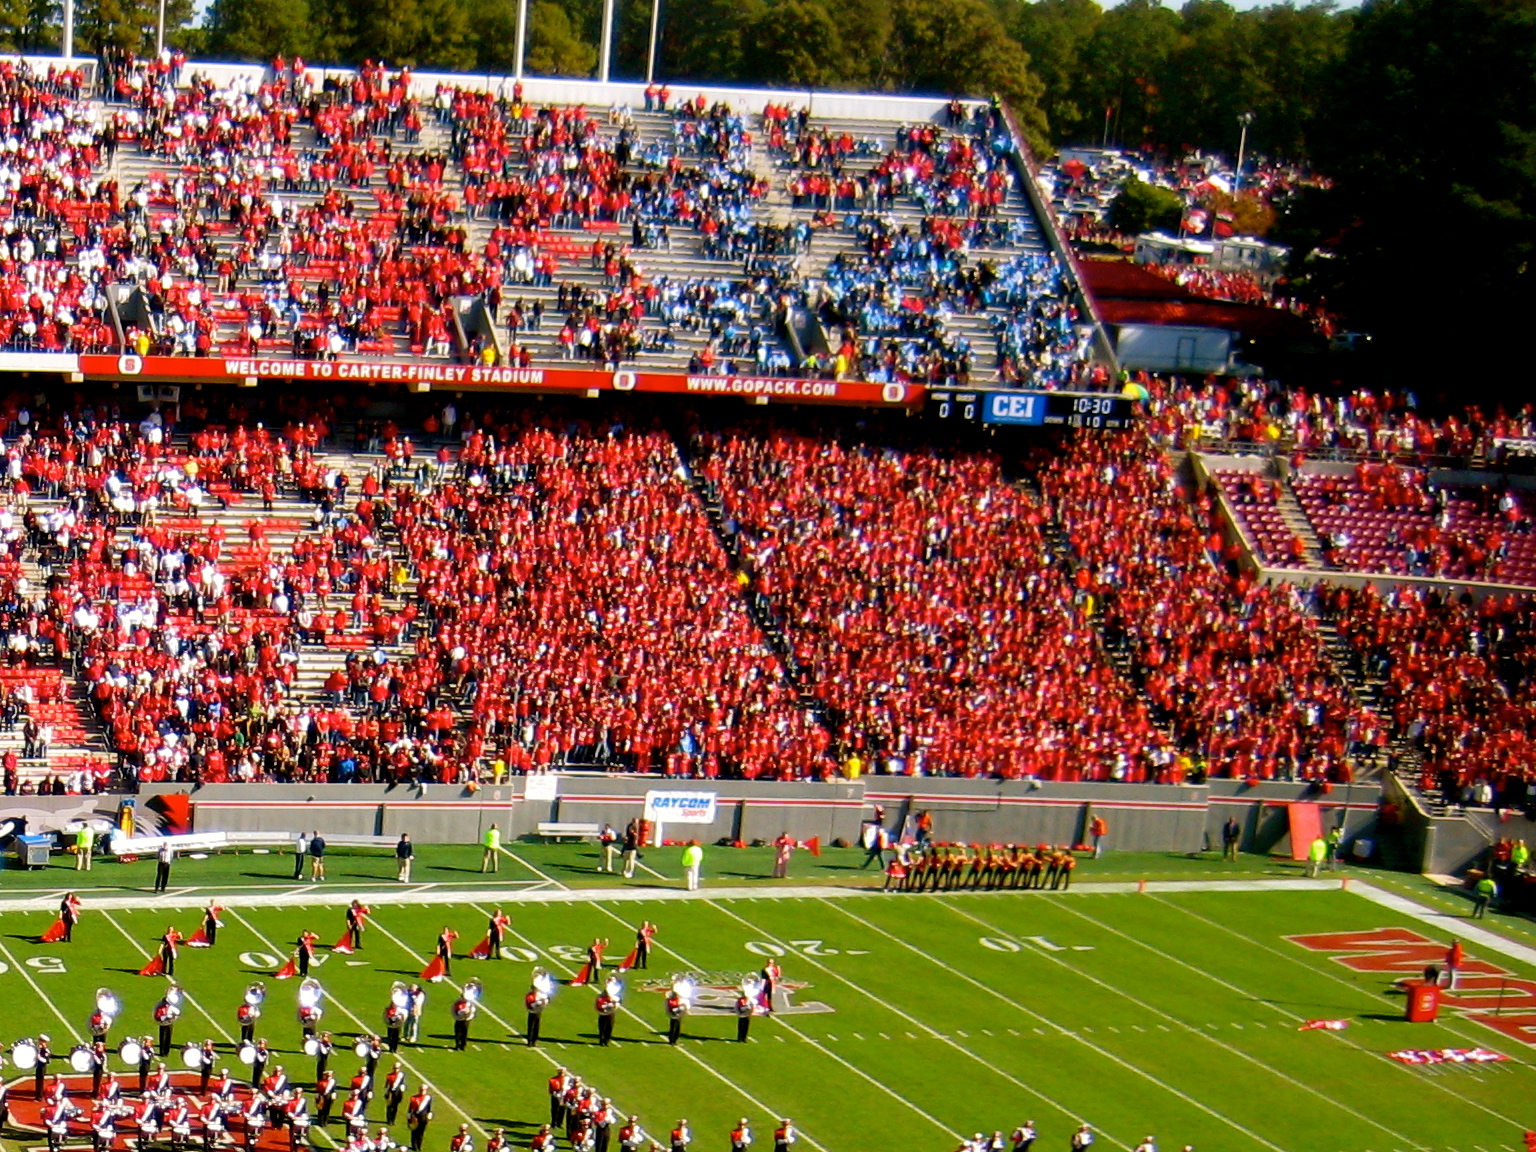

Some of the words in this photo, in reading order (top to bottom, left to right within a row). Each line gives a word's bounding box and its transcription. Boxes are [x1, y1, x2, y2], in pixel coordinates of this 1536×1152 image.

[225, 360, 306, 377] WELCOME
[311, 363, 333, 377] TO
[338, 364, 466, 382] CARTER-FINLEY
[471, 368, 544, 385] STADIUM
[686, 377, 837, 396] WWW.GOPACK.COM
[939, 403, 949, 418] 0
[964, 404, 975, 419] 0
[992, 395, 1035, 418] CEI
[1073, 398, 1112, 415] 10:30
[651, 797, 712, 809] RAYCOM
[681, 808, 707, 817] Sports
